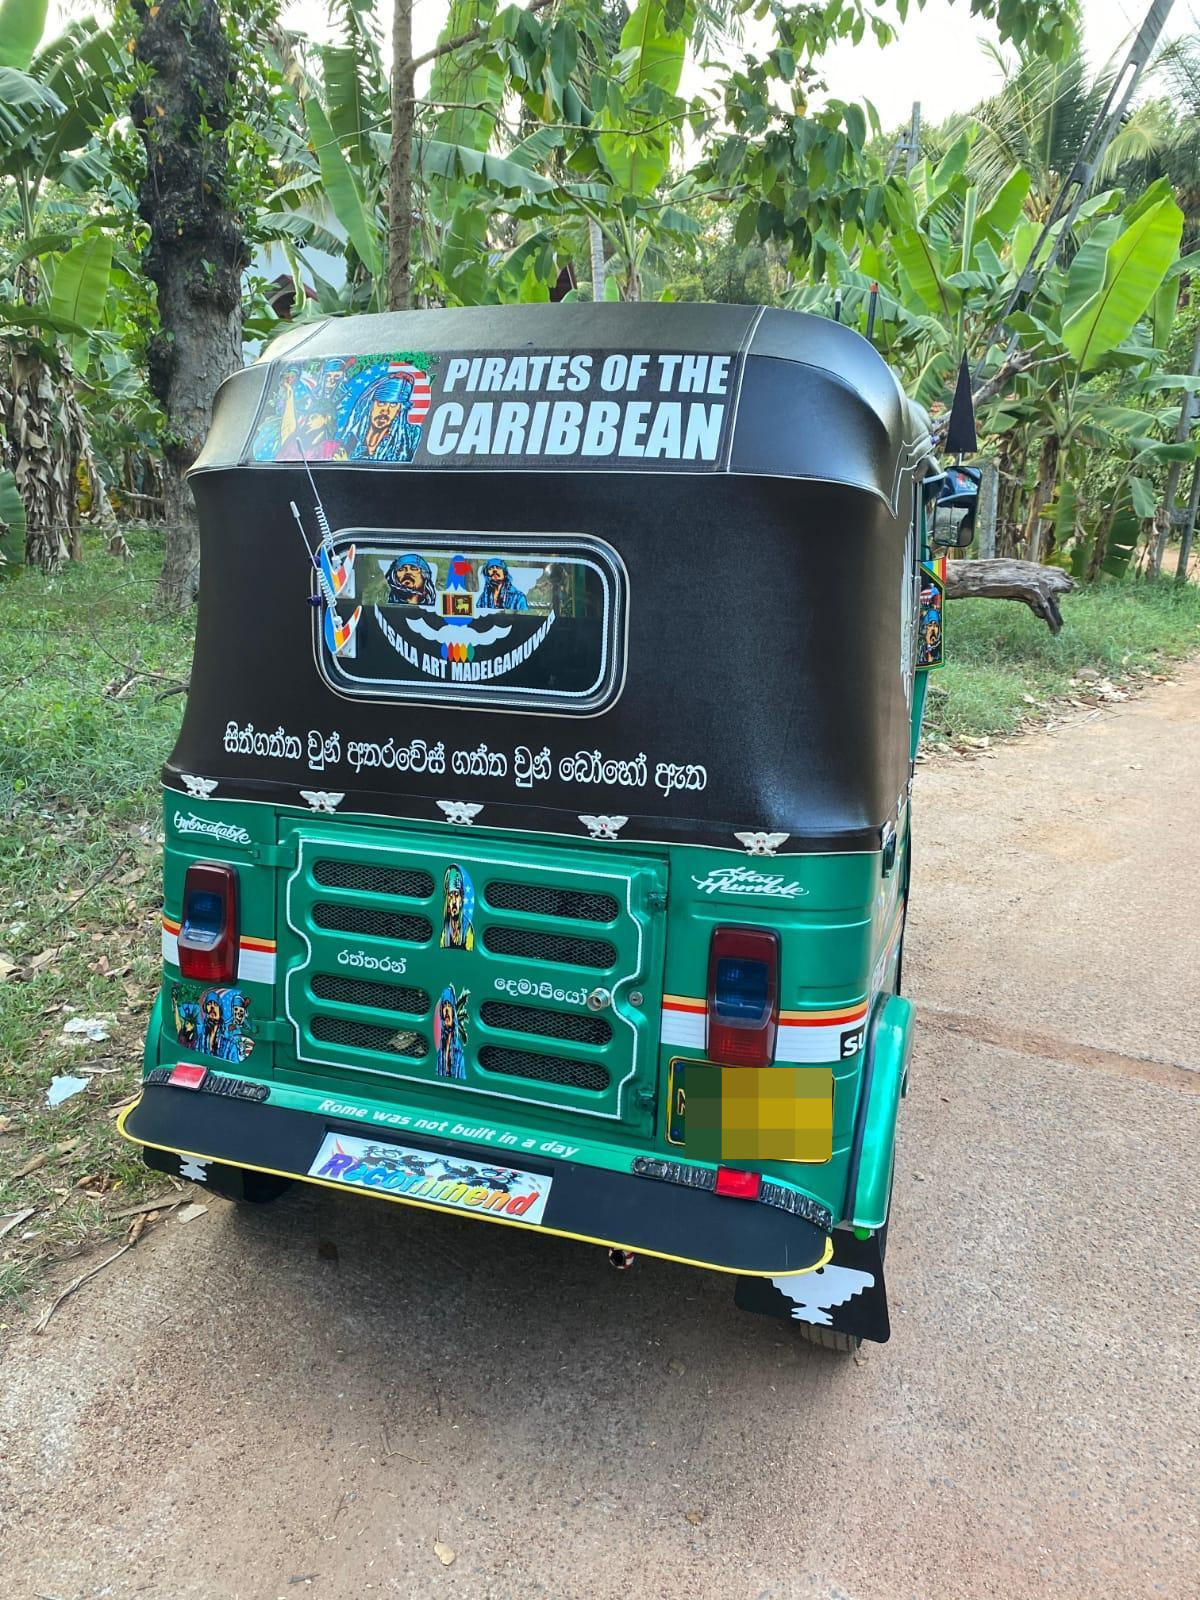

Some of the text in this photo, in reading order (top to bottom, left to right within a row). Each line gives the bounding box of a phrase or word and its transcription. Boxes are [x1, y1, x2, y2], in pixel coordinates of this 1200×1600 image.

[442, 354, 731, 395] PIRATES OF THE
[426, 401, 725, 461] CARIBBEAN
[422, 652, 448, 680] ART
[451, 608, 556, 682] MADELGAMUWA
[451, 743, 508, 777] ගත්ත
[691, 874, 810, 898] Humble
[337, 949, 407, 974] රත්තරන්
[318, 1099, 580, 1159] Rome was not built in a day
[317, 1152, 541, 1217] Recommend
